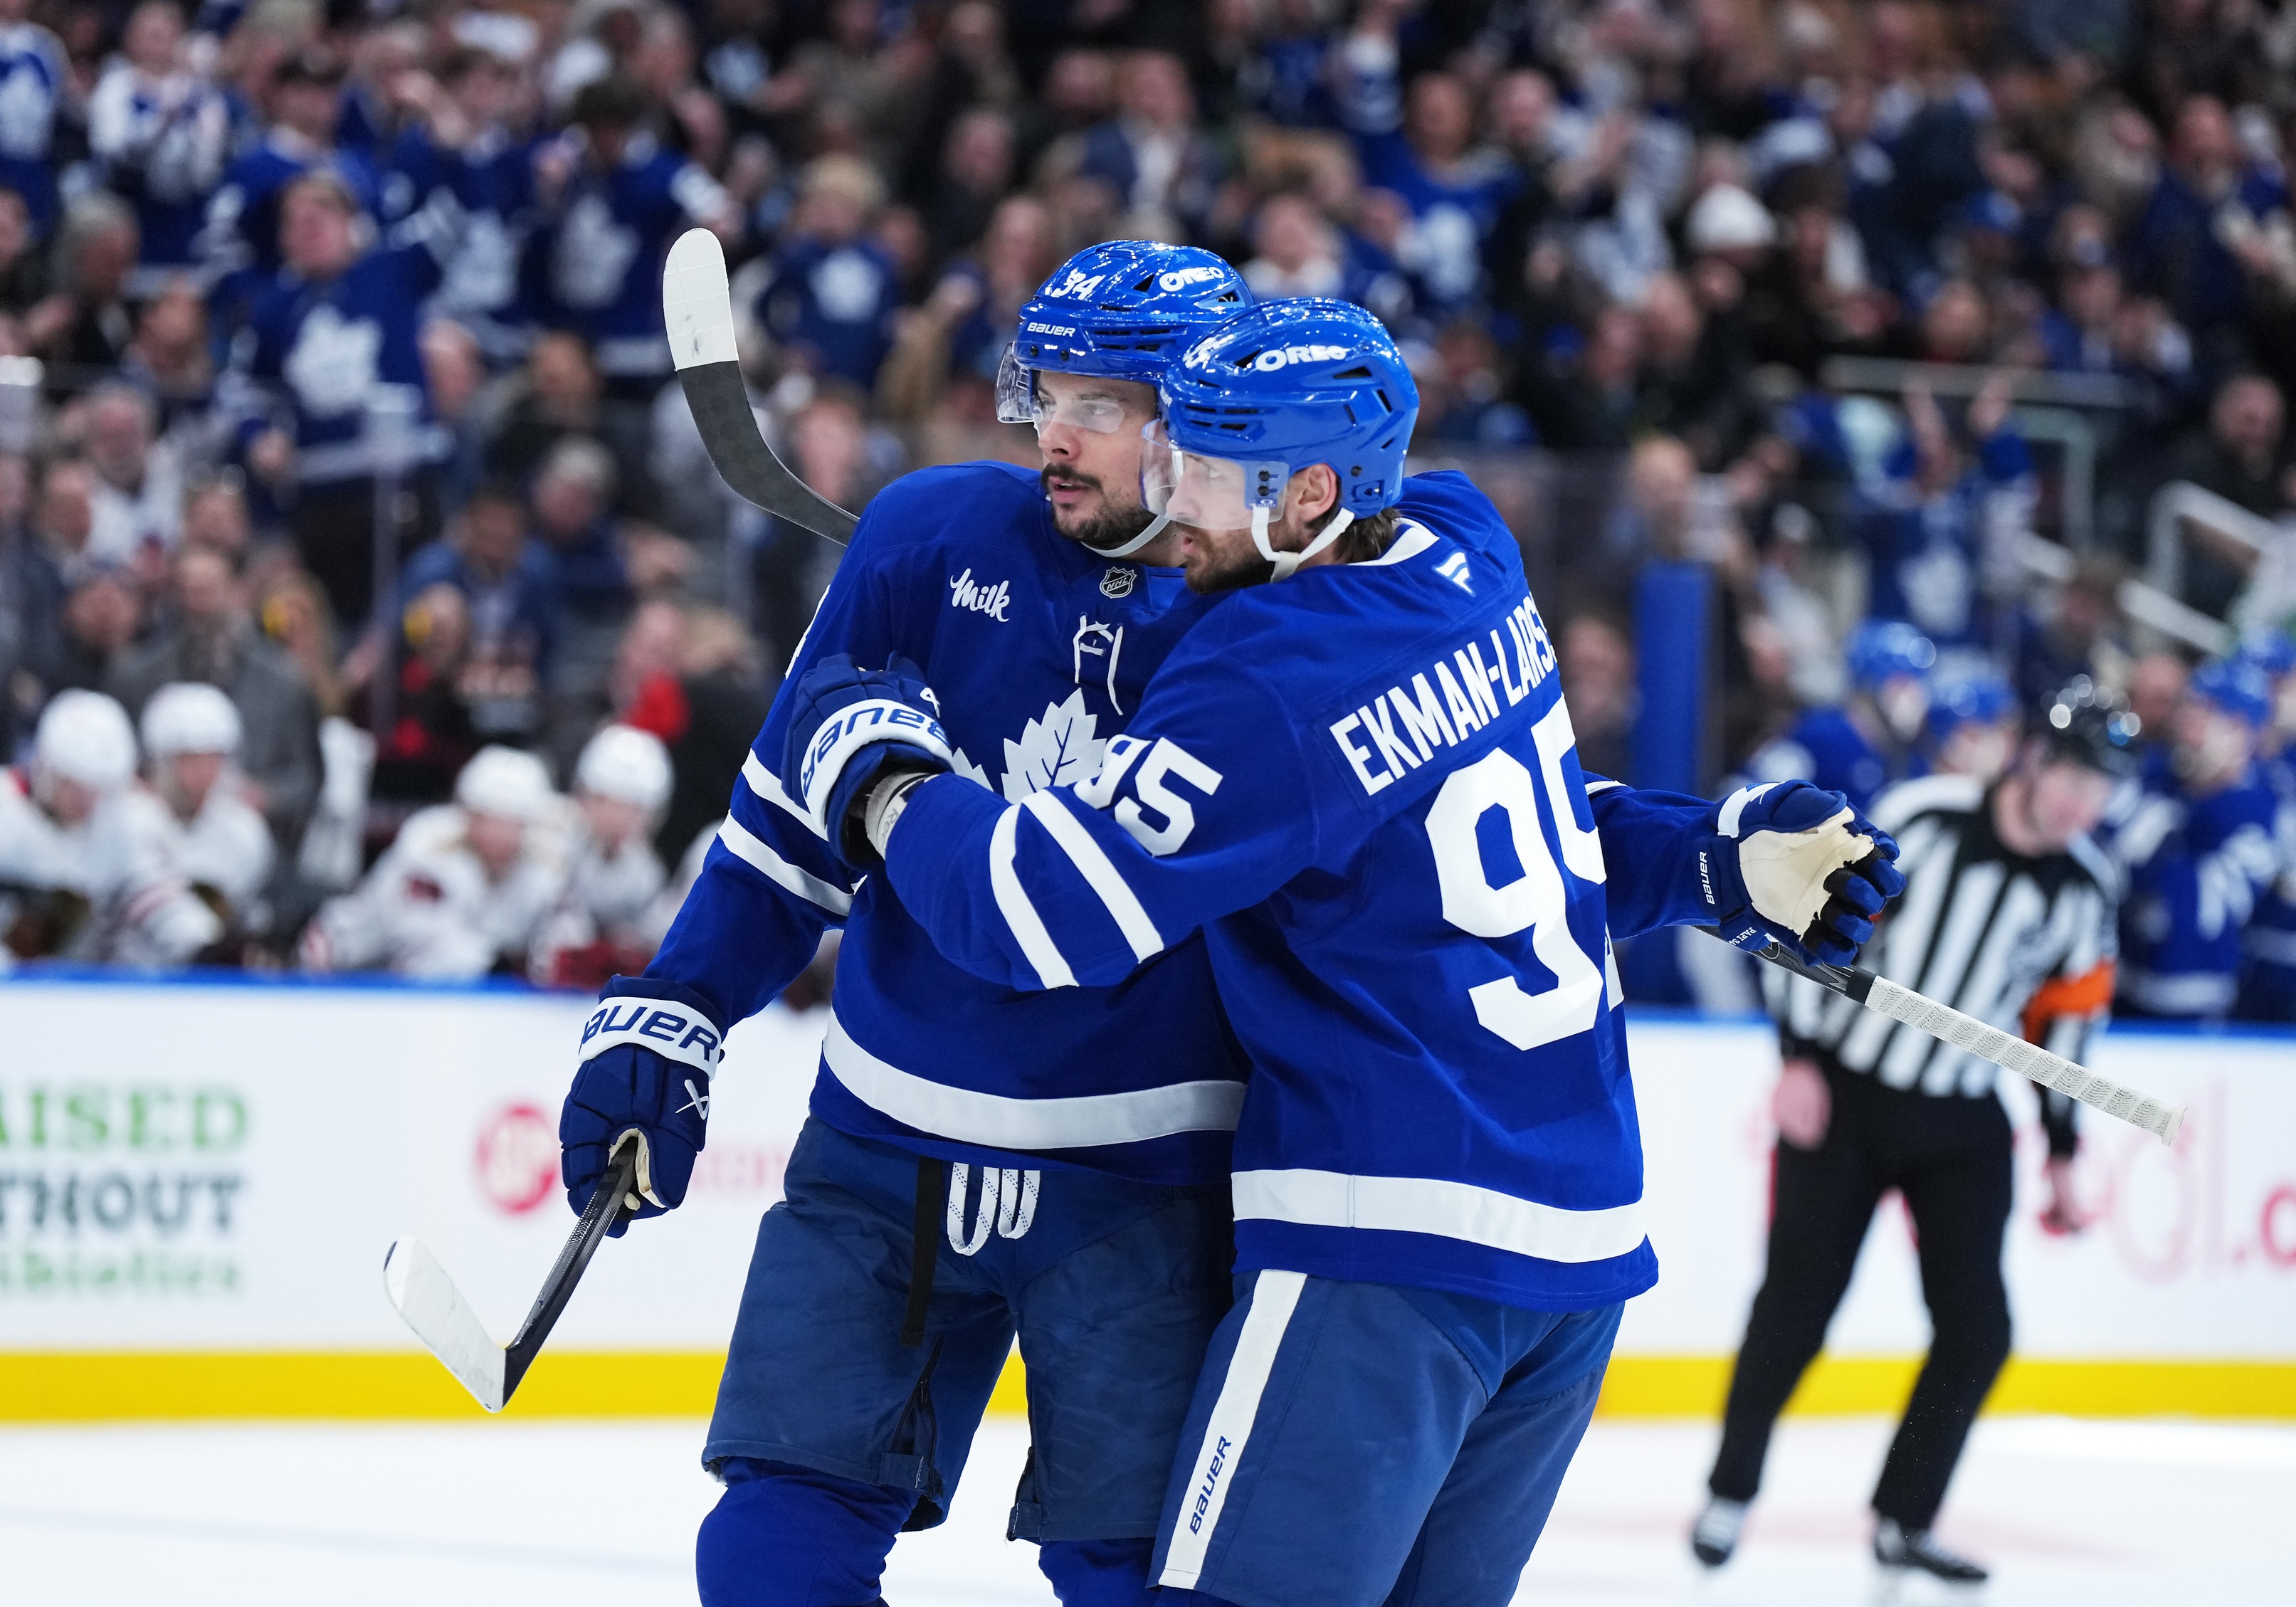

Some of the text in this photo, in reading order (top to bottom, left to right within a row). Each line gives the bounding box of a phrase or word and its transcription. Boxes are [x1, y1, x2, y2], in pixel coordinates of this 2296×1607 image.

[1050, 268, 1107, 300] 34
[1159, 266, 1225, 293] OREO
[1255, 344, 1347, 372] OREO
[949, 567, 1010, 623] Milk
[1106, 576, 1129, 591] NHL
[1425, 695, 1626, 1051] 95
[1735, 927, 1757, 942] PAPI
